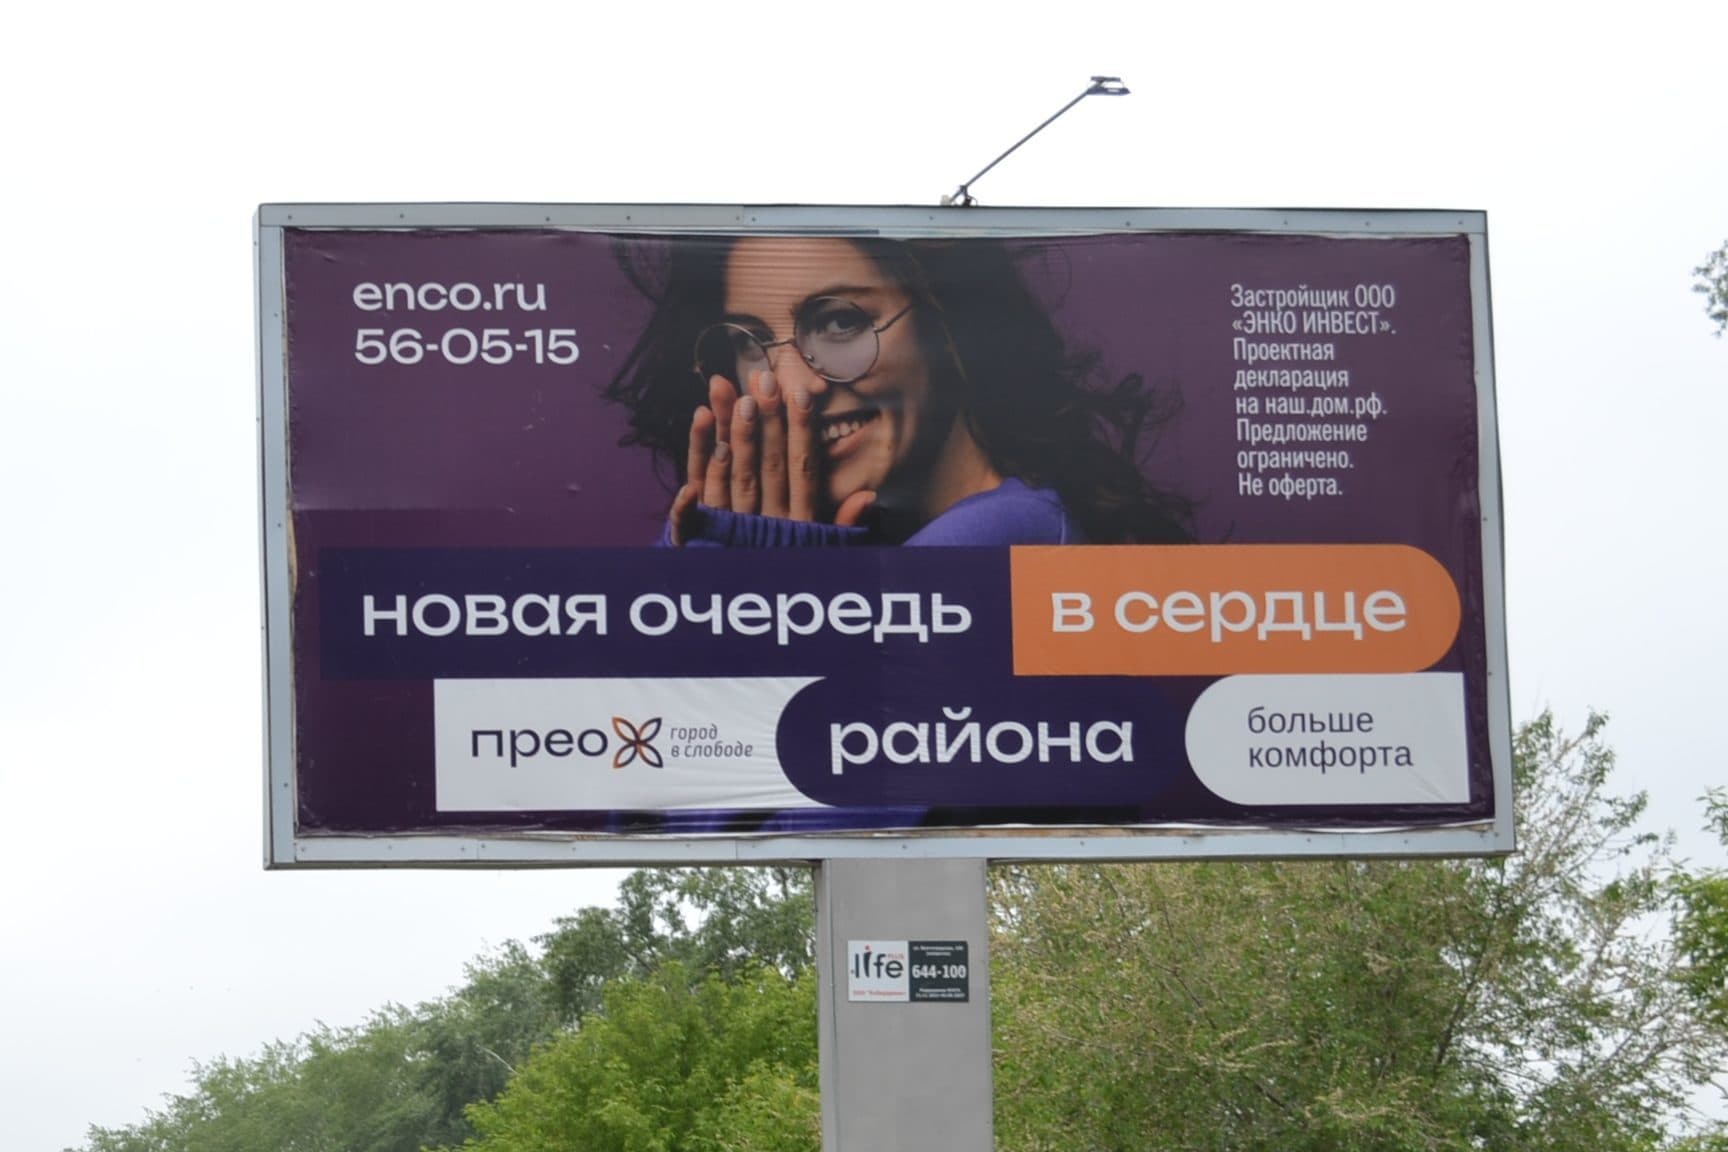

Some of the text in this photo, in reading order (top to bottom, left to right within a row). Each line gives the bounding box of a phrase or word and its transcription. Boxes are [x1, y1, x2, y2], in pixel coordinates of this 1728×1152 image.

[352, 282, 547, 311] enco.ru
[1231, 284, 1395, 310] Застройщик ООО
[1232, 311, 1396, 334] «ЭНКО ИНВЕСТ».
[355, 328, 580, 365] 56-05-15
[1233, 337, 1334, 364] Проектная
[1234, 370, 1349, 391] декларация
[1236, 392, 1387, 418] на наш.дом.рф.
[1237, 418, 1367, 445] Предложение
[1237, 450, 1354, 472] ограничено.
[1238, 473, 1343, 500] Не оферта.
[363, 590, 1406, 646] новая очередь в сердце
[670, 724, 718, 742] город
[1247, 706, 1374, 734] больше
[471, 728, 609, 768] прео
[671, 741, 753, 758] в слободе
[830, 706, 1134, 775] района
[1249, 740, 1414, 775] комфорта
[912, 964, 967, 979] 644-100
